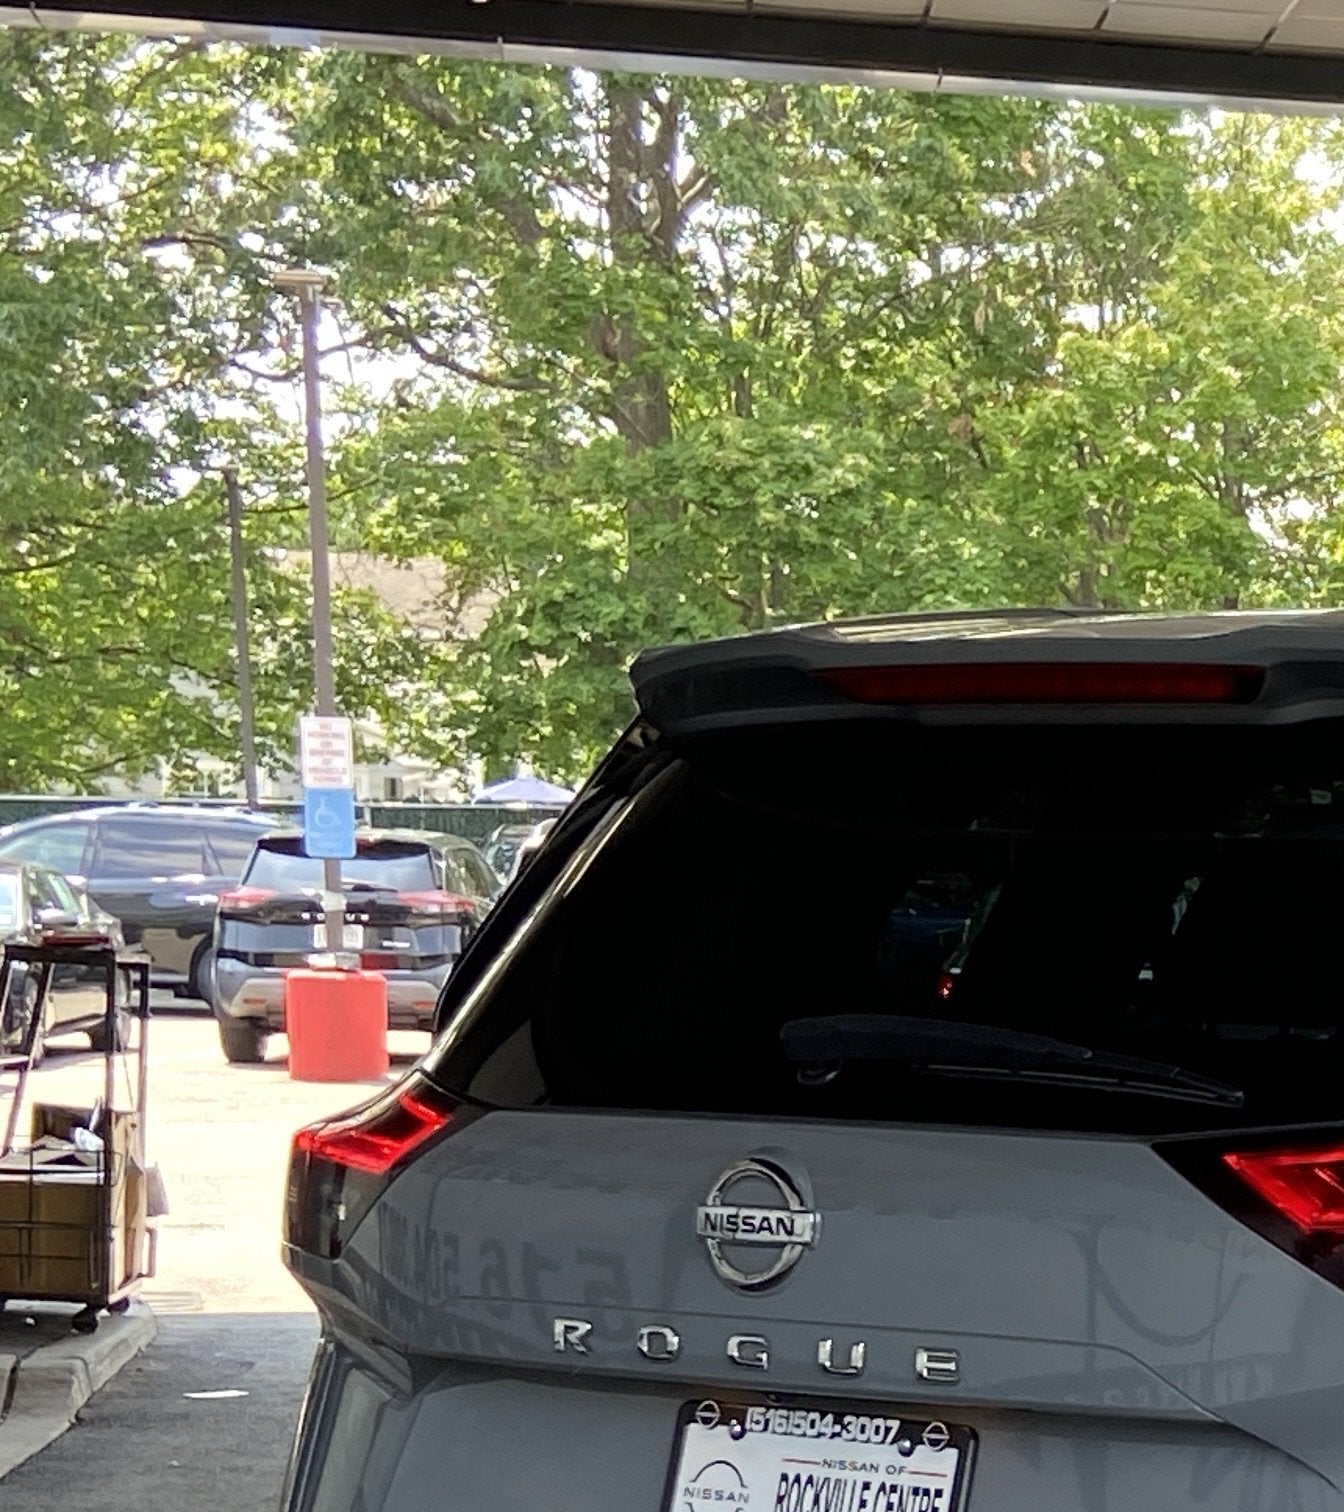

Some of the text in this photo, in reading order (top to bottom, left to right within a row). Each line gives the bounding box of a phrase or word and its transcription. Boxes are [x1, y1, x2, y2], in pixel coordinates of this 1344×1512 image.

[703, 1211, 796, 1238] NISSAN
[552, 1317, 962, 1382] ROGUE
[822, 1458, 907, 1477] NISSAN OF
[683, 1486, 750, 1503] NISSAN
